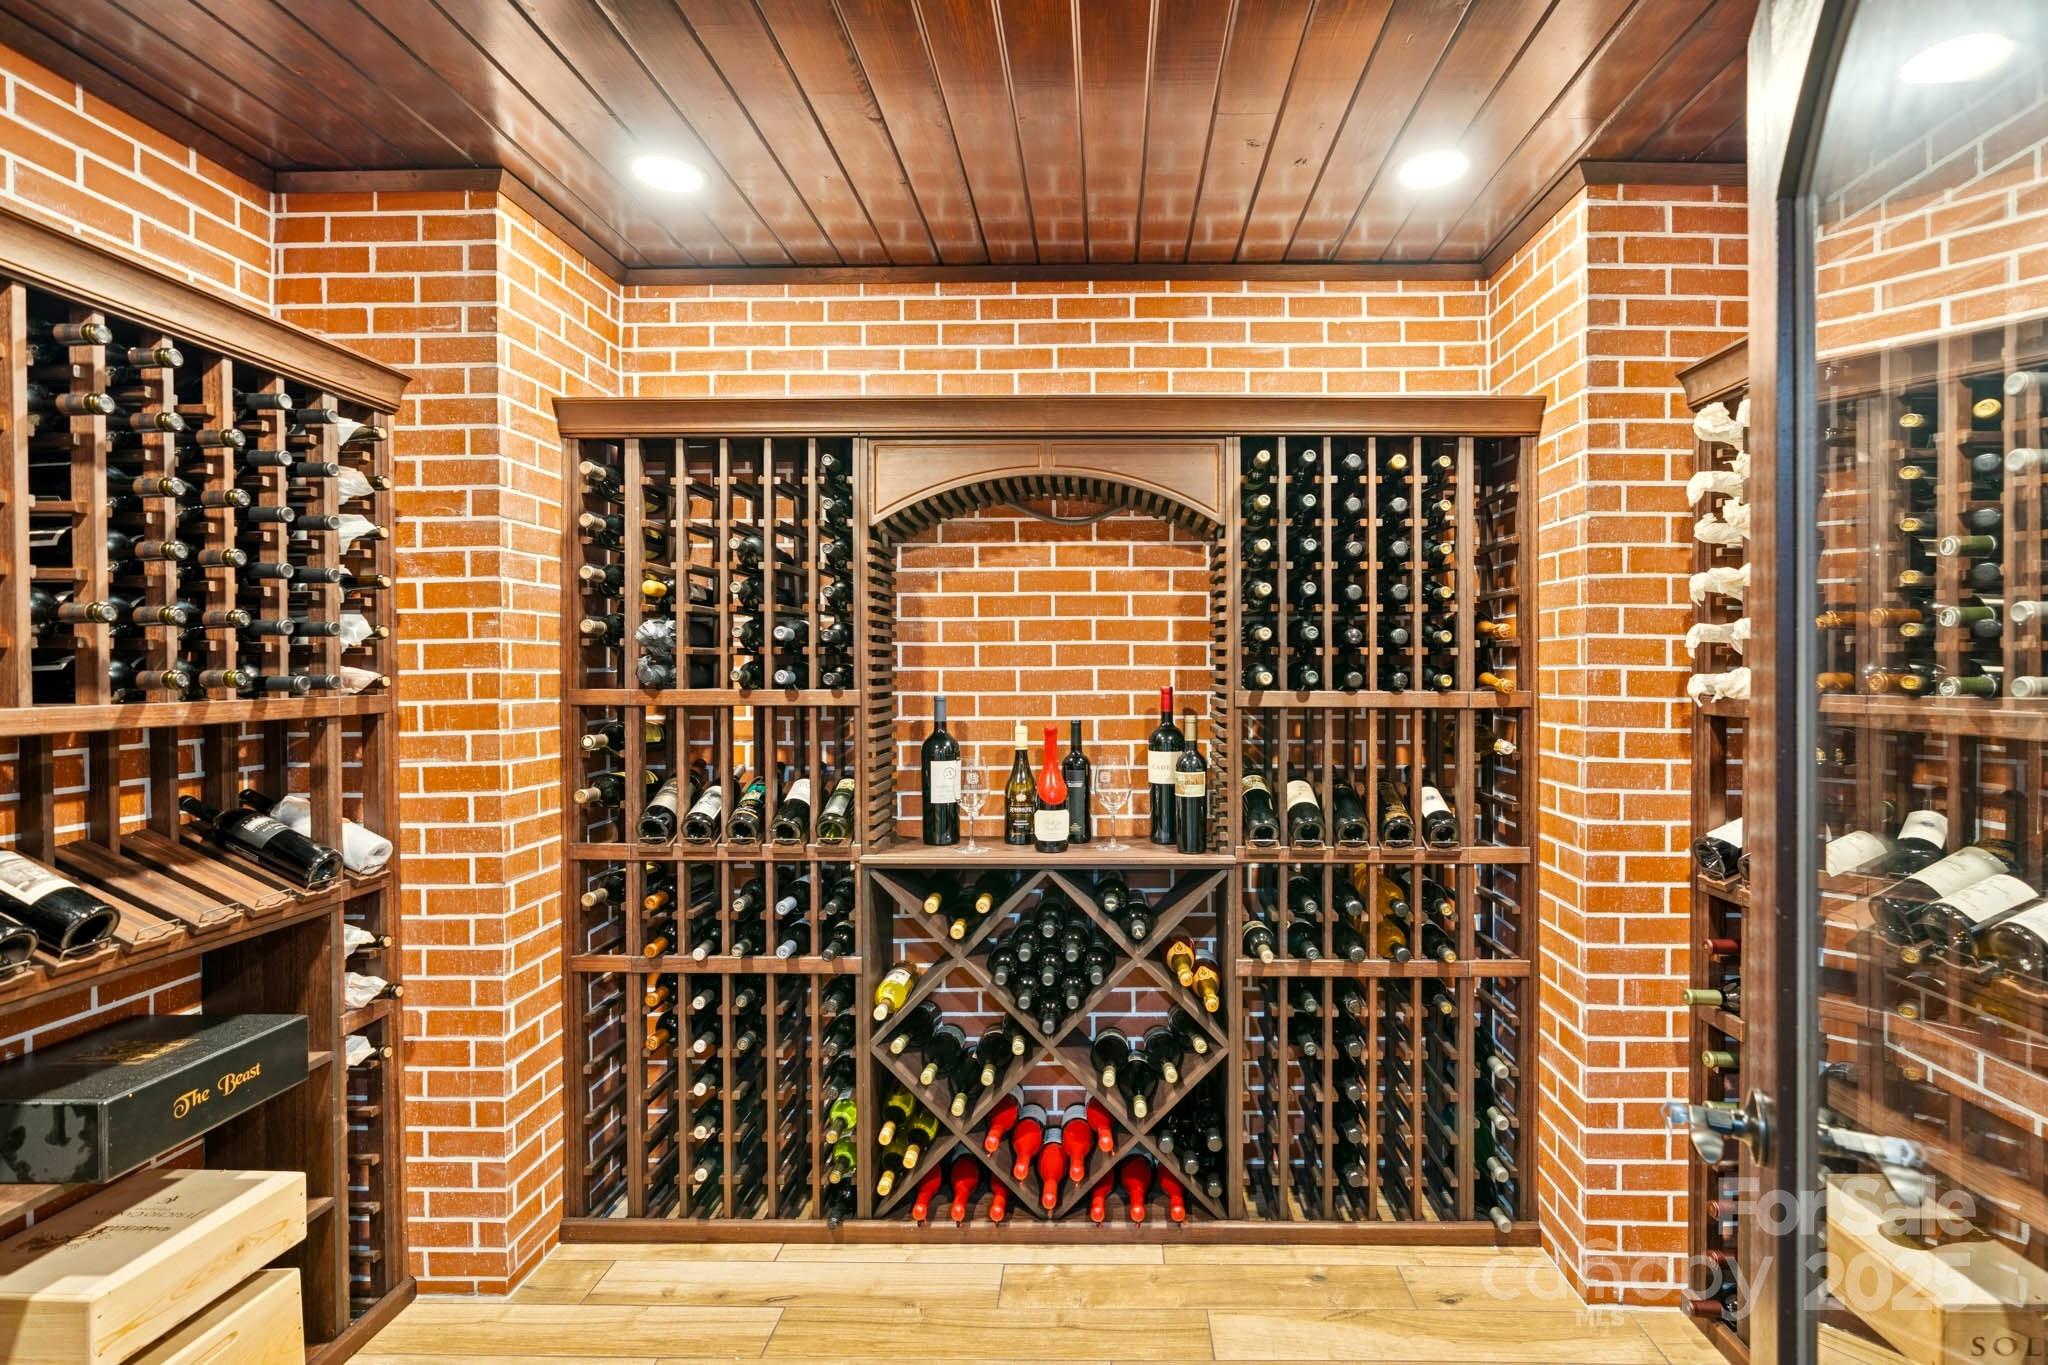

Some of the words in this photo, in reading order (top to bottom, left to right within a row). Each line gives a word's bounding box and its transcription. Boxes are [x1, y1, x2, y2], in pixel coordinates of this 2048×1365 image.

[173, 1088, 210, 1118] The
[217, 1062, 261, 1096] Beast
[1971, 1336, 2048, 1357] SOL
